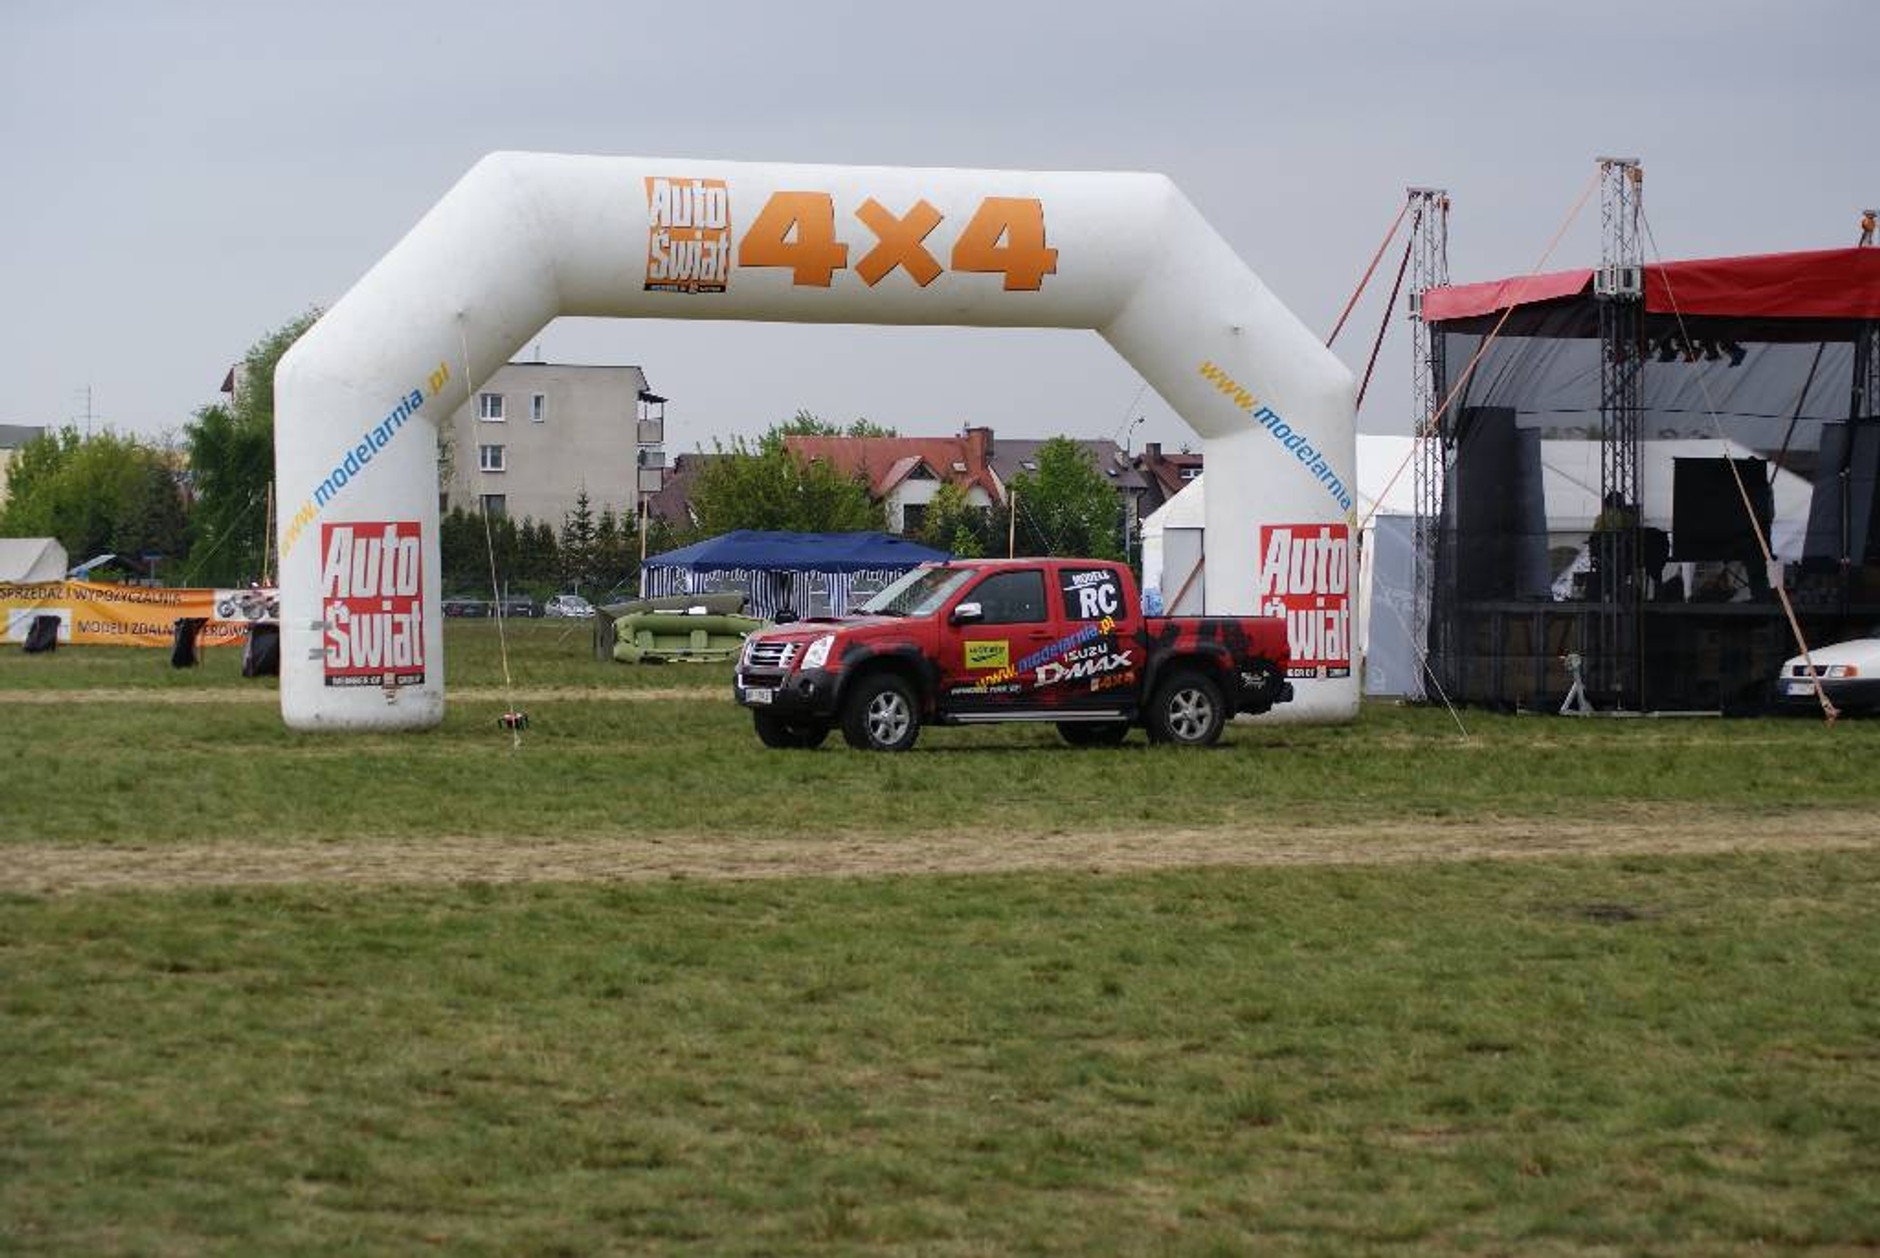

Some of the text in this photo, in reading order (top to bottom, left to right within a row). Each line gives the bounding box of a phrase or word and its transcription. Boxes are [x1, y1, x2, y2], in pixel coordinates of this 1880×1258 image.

[647, 177, 727, 229] Auto
[738, 191, 1058, 290] 4x4
[323, 524, 421, 598] Auto
[1260, 527, 1348, 595] Auto
[1079, 584, 1118, 618] RC
[1064, 642, 1108, 663] ISUZU
